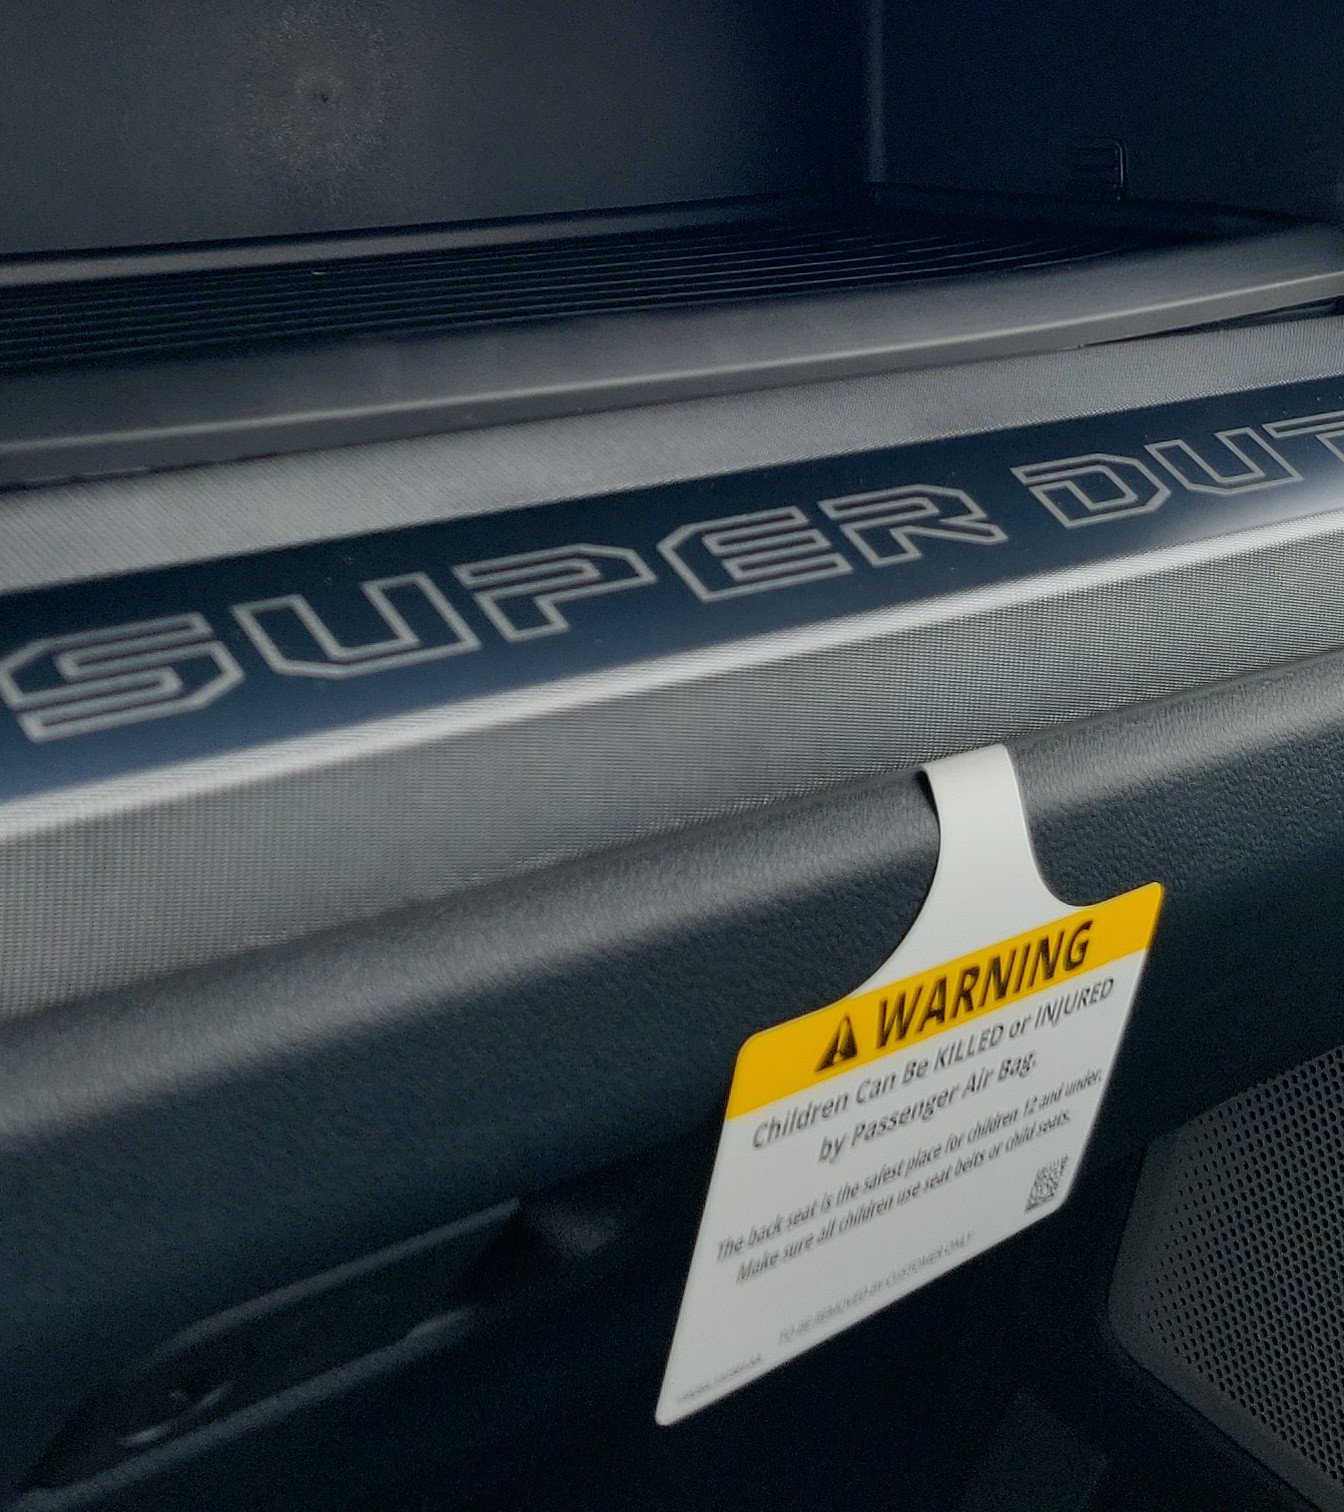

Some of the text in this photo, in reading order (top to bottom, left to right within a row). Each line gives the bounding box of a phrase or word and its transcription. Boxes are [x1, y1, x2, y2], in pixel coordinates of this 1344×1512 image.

[752, 977, 1115, 1150] Children Can Be KILLED or INJURED
[875, 919, 1094, 1050] WARNING
[716, 1236, 745, 1261] The
[747, 1216, 783, 1248] back
[786, 1200, 818, 1229] seat
[819, 1195, 832, 1214] is
[835, 1182, 860, 1207] the
[862, 1159, 905, 1194] safest
[904, 1143, 942, 1179] place
[944, 1132, 965, 1154] for
[966, 1107, 1019, 1144] children
[1023, 1095, 1039, 1118] 12
[1038, 1083, 1065, 1111] and
[818, 1050, 1037, 1164] by Passenger Air Bag.
[736, 1251, 780, 1283] Make
[782, 1233, 815, 1262] sure
[816, 1218, 837, 1244] all
[838, 1195, 895, 1234] children
[896, 1181, 922, 1206] use
[922, 1164, 953, 1194] seat
[953, 1149, 986, 1178] belts
[987, 1141, 1003, 1161] or
[1004, 1121, 1037, 1153] child
